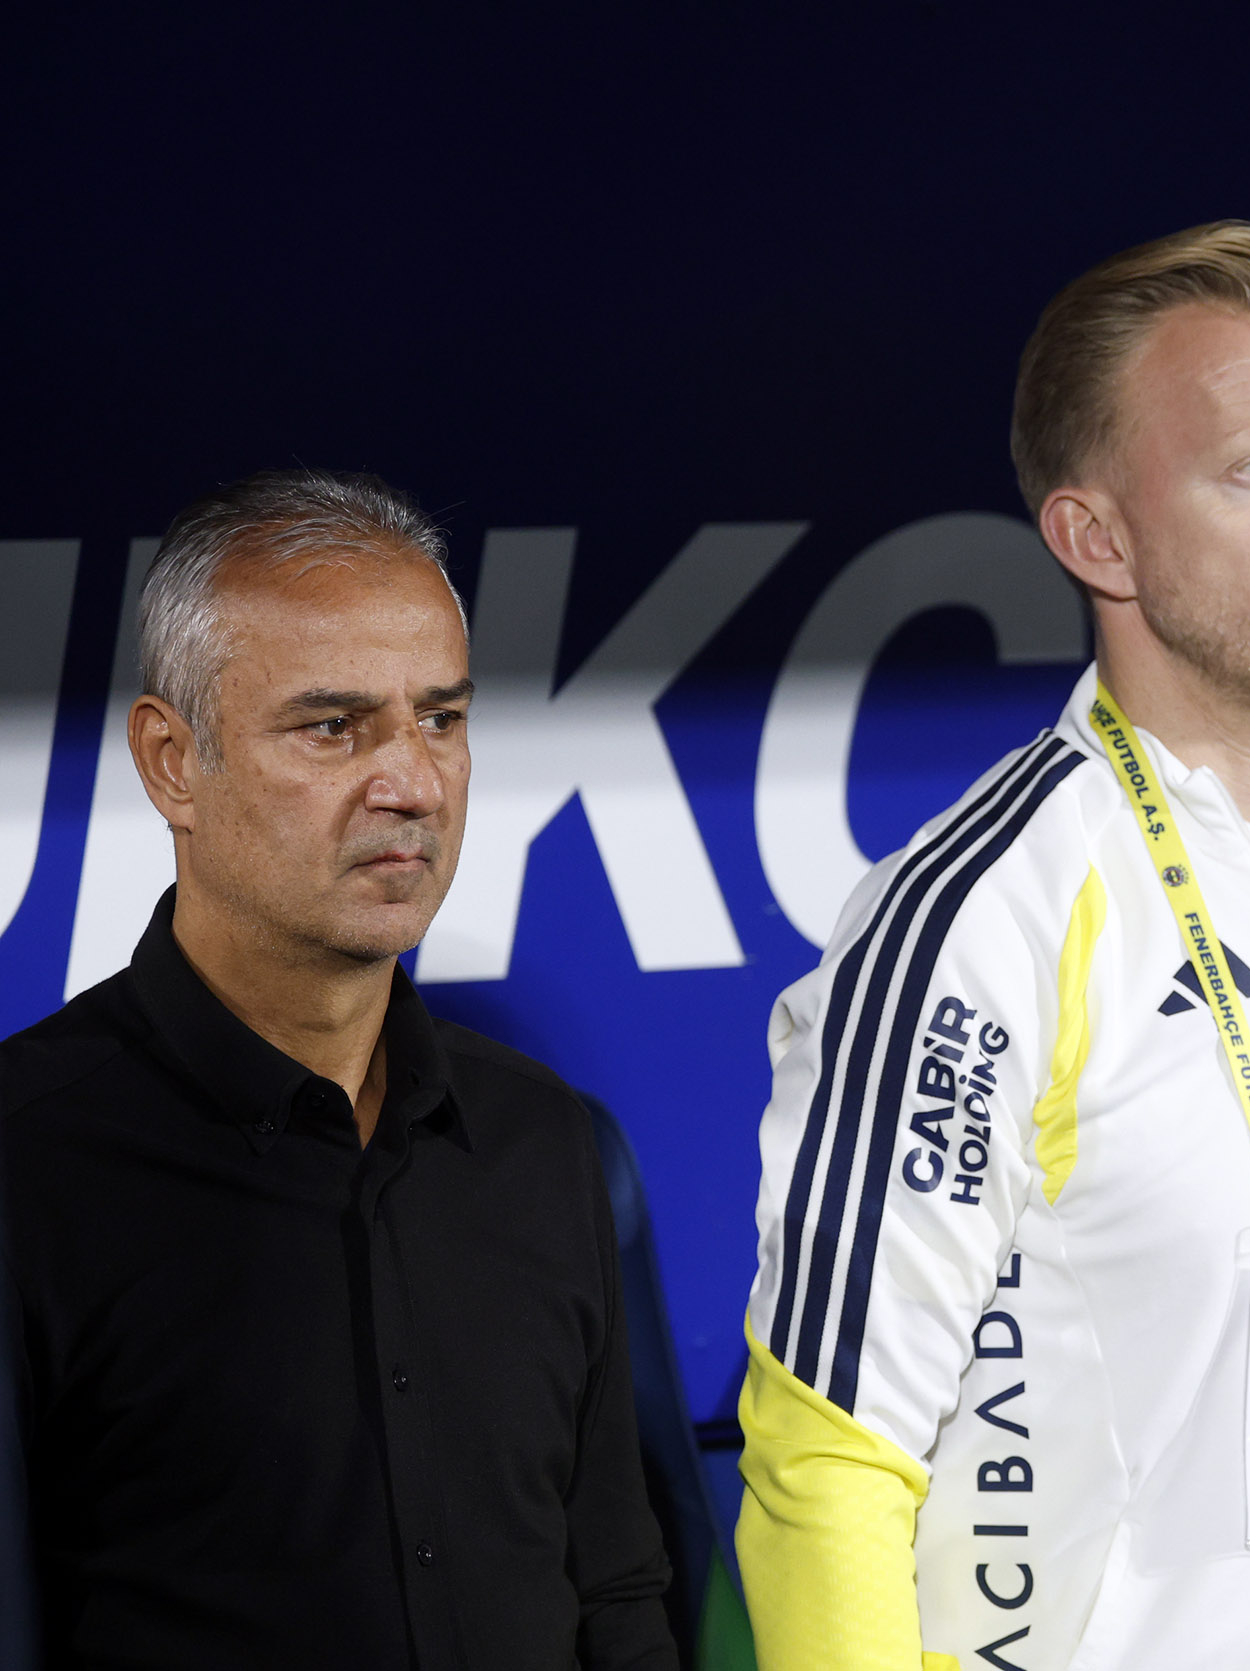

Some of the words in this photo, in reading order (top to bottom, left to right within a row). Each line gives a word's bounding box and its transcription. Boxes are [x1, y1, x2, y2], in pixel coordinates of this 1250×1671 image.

[1107, 728, 1151, 799] FUTBOL
[1142, 804, 1165, 841] A.Ş.
[1184, 911, 1244, 1047] FENERBAHÇE
